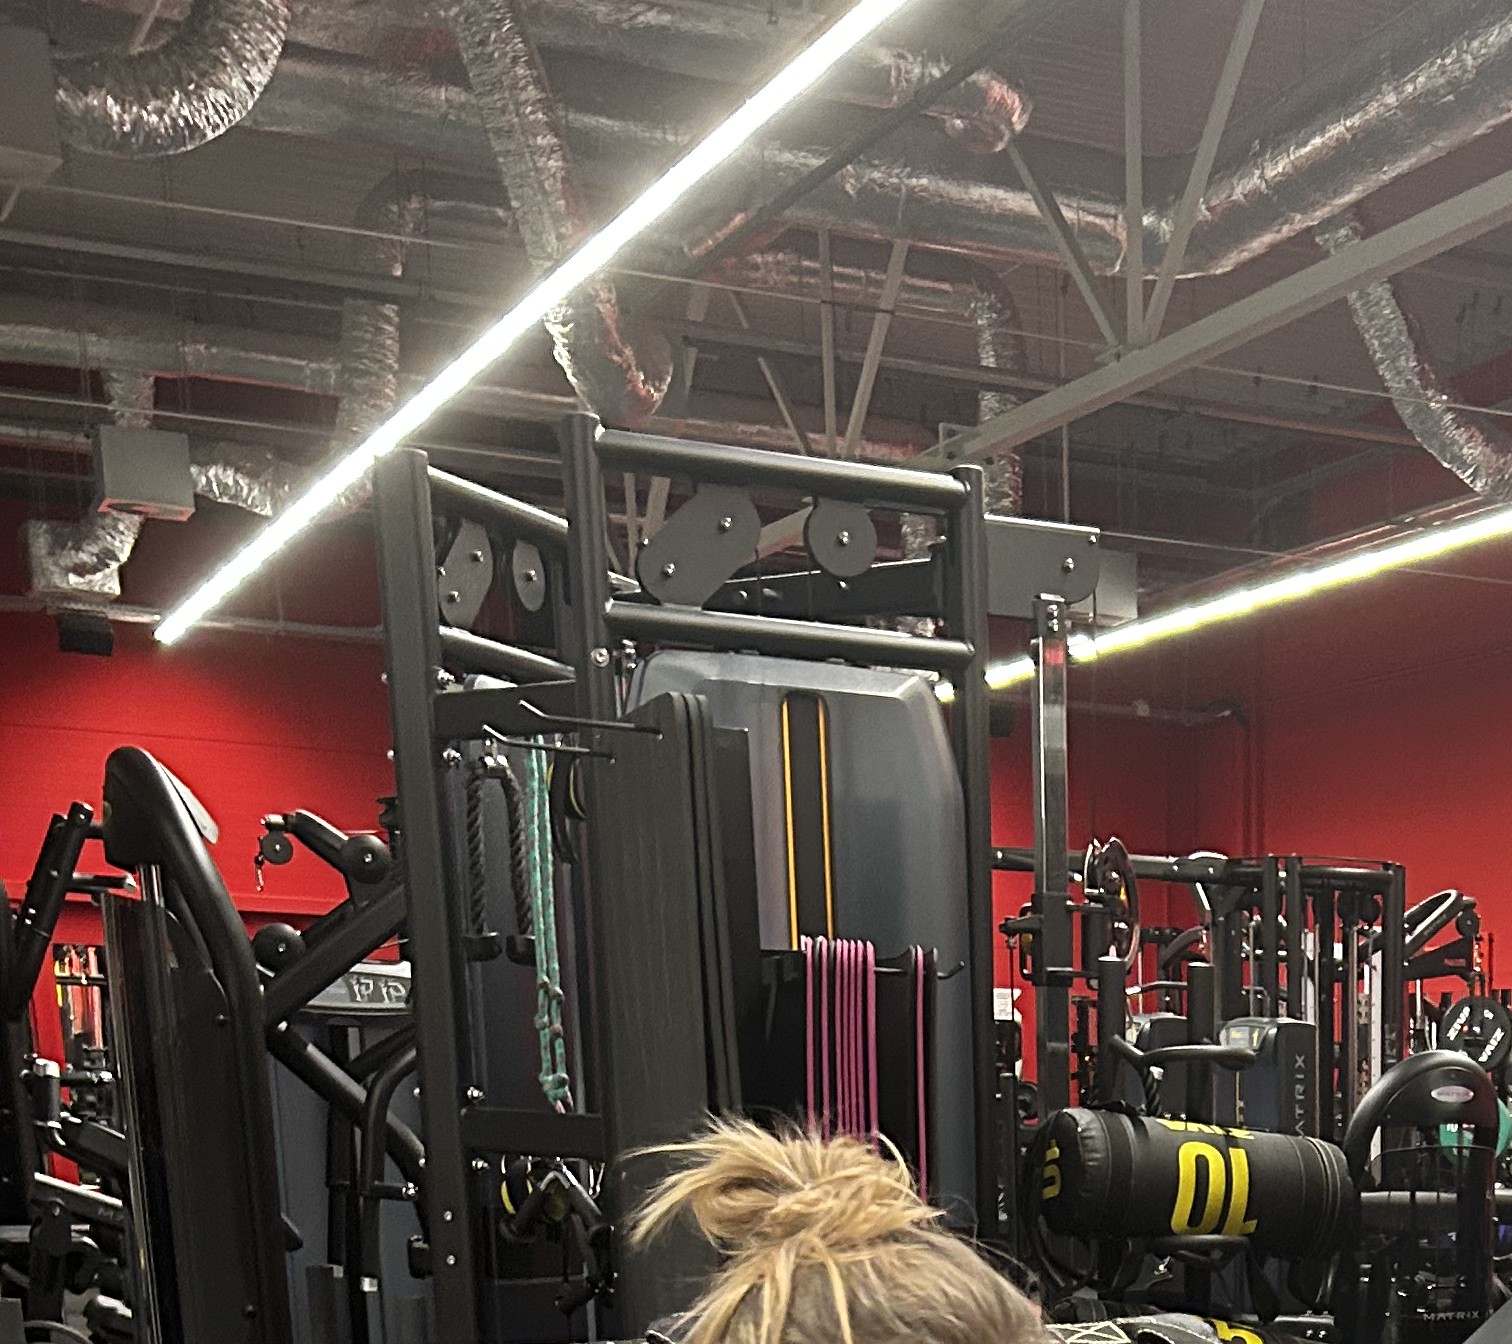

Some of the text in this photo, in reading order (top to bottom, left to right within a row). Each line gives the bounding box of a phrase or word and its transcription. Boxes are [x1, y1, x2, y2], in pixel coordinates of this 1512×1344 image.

[1294, 1054, 1306, 1138] ATRIX
[1170, 1141, 1258, 1236] 10
[1422, 1310, 1480, 1321] MATRIX
